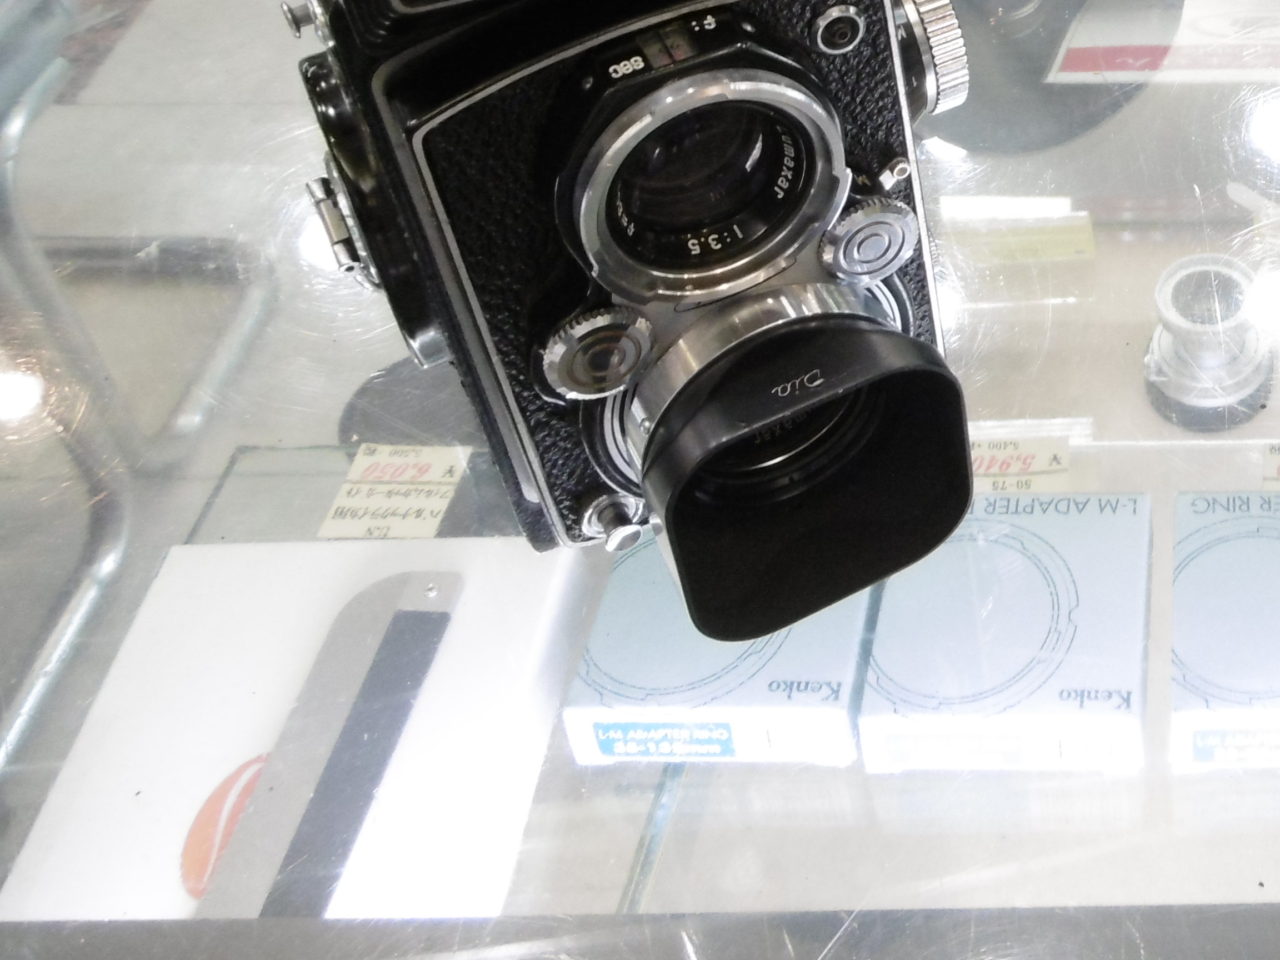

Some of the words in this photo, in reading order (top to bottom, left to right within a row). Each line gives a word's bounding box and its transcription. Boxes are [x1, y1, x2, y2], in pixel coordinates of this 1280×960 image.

[770, 368, 825, 397] Dia
[991, 479, 1032, 491] 50-75
[984, 497, 1091, 515] ADAPTER
[1190, 496, 1251, 515] RING
[767, 679, 842, 702] Kenko
[1058, 688, 1133, 711] Kenko
